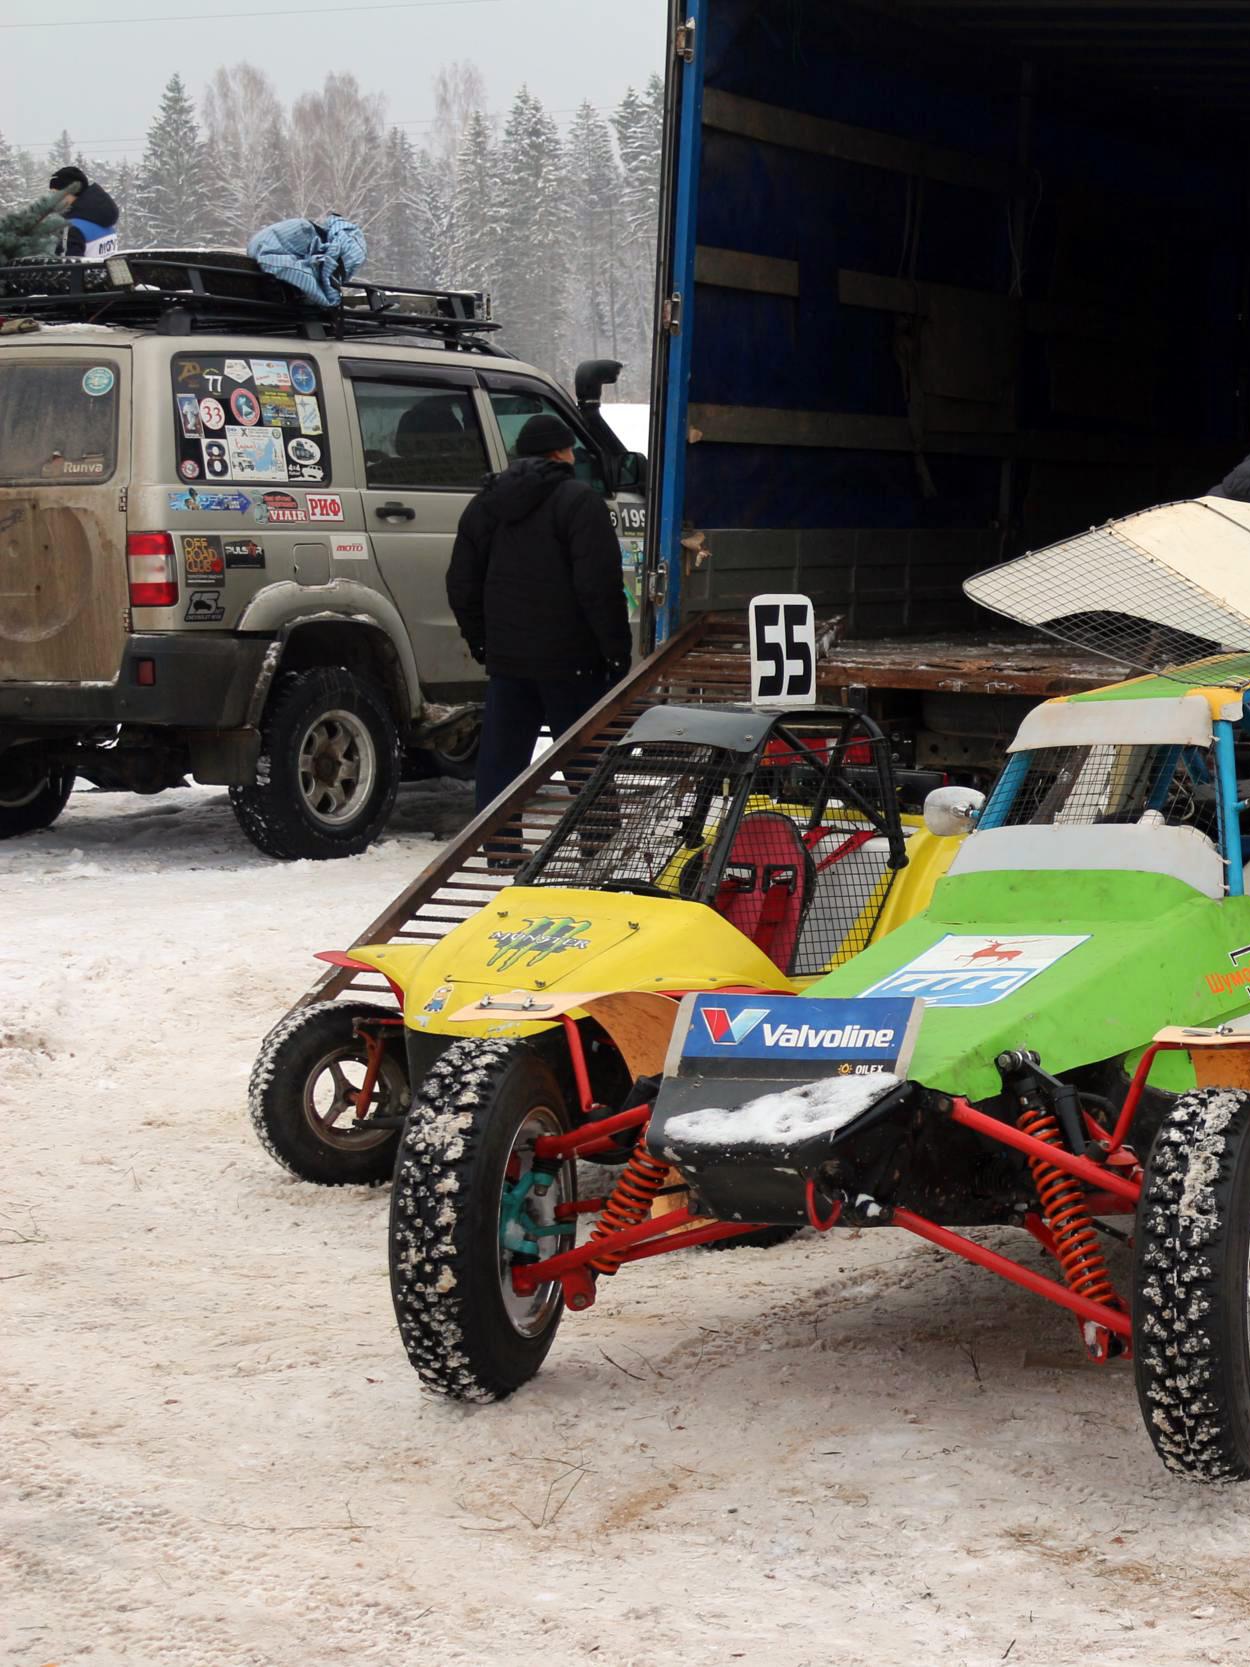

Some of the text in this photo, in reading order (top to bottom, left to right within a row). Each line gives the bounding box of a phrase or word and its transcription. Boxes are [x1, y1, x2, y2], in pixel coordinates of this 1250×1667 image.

[203, 405, 222, 424] 33
[63, 462, 103, 473] Runva
[269, 510, 306, 521] VIAIR
[308, 498, 341, 517] РИФ
[184, 537, 208, 548] OFF
[185, 548, 217, 561] ROAD
[187, 560, 212, 573] CLUB
[754, 604, 812, 697] 55
[492, 930, 589, 950] MONSTER
[762, 1023, 894, 1048] Valvoline
